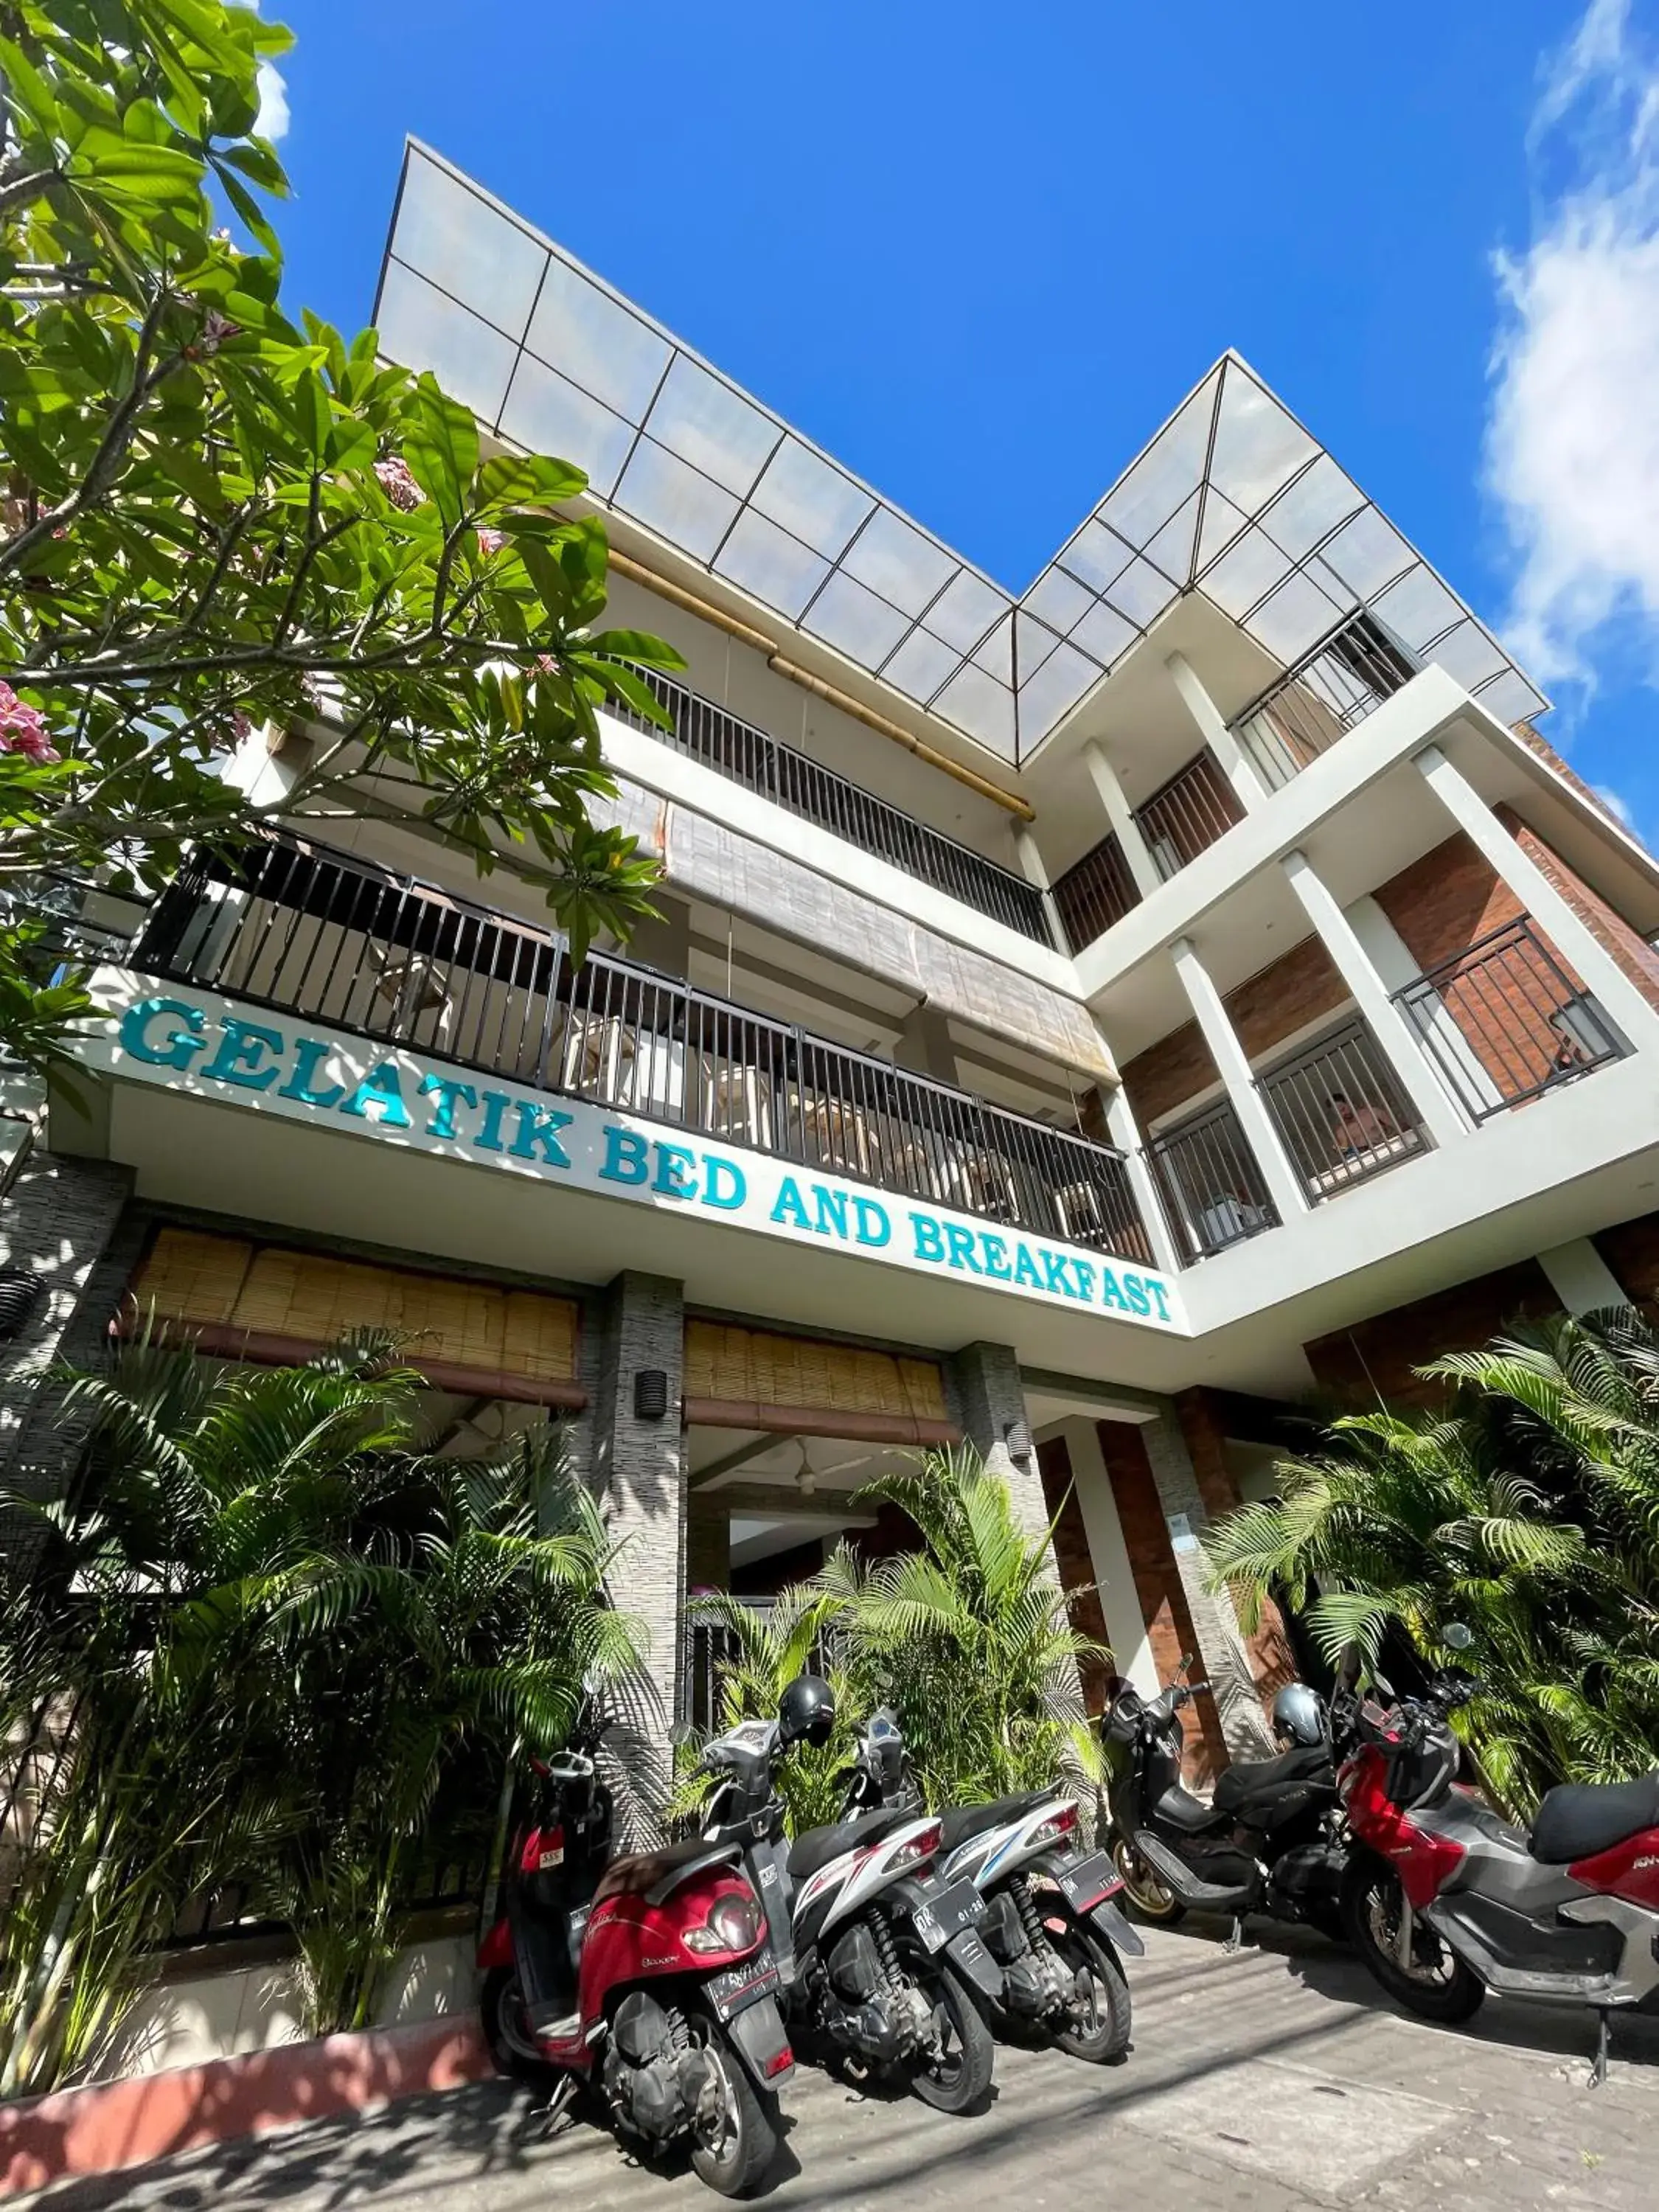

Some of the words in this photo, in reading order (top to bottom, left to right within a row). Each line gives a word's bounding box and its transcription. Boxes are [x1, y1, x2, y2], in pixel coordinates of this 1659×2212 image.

[118, 998, 575, 1169] GELATIK
[599, 1125, 748, 1211] BED
[770, 1176, 892, 1248] AND
[908, 1212, 1172, 1323] BREAKFAST
